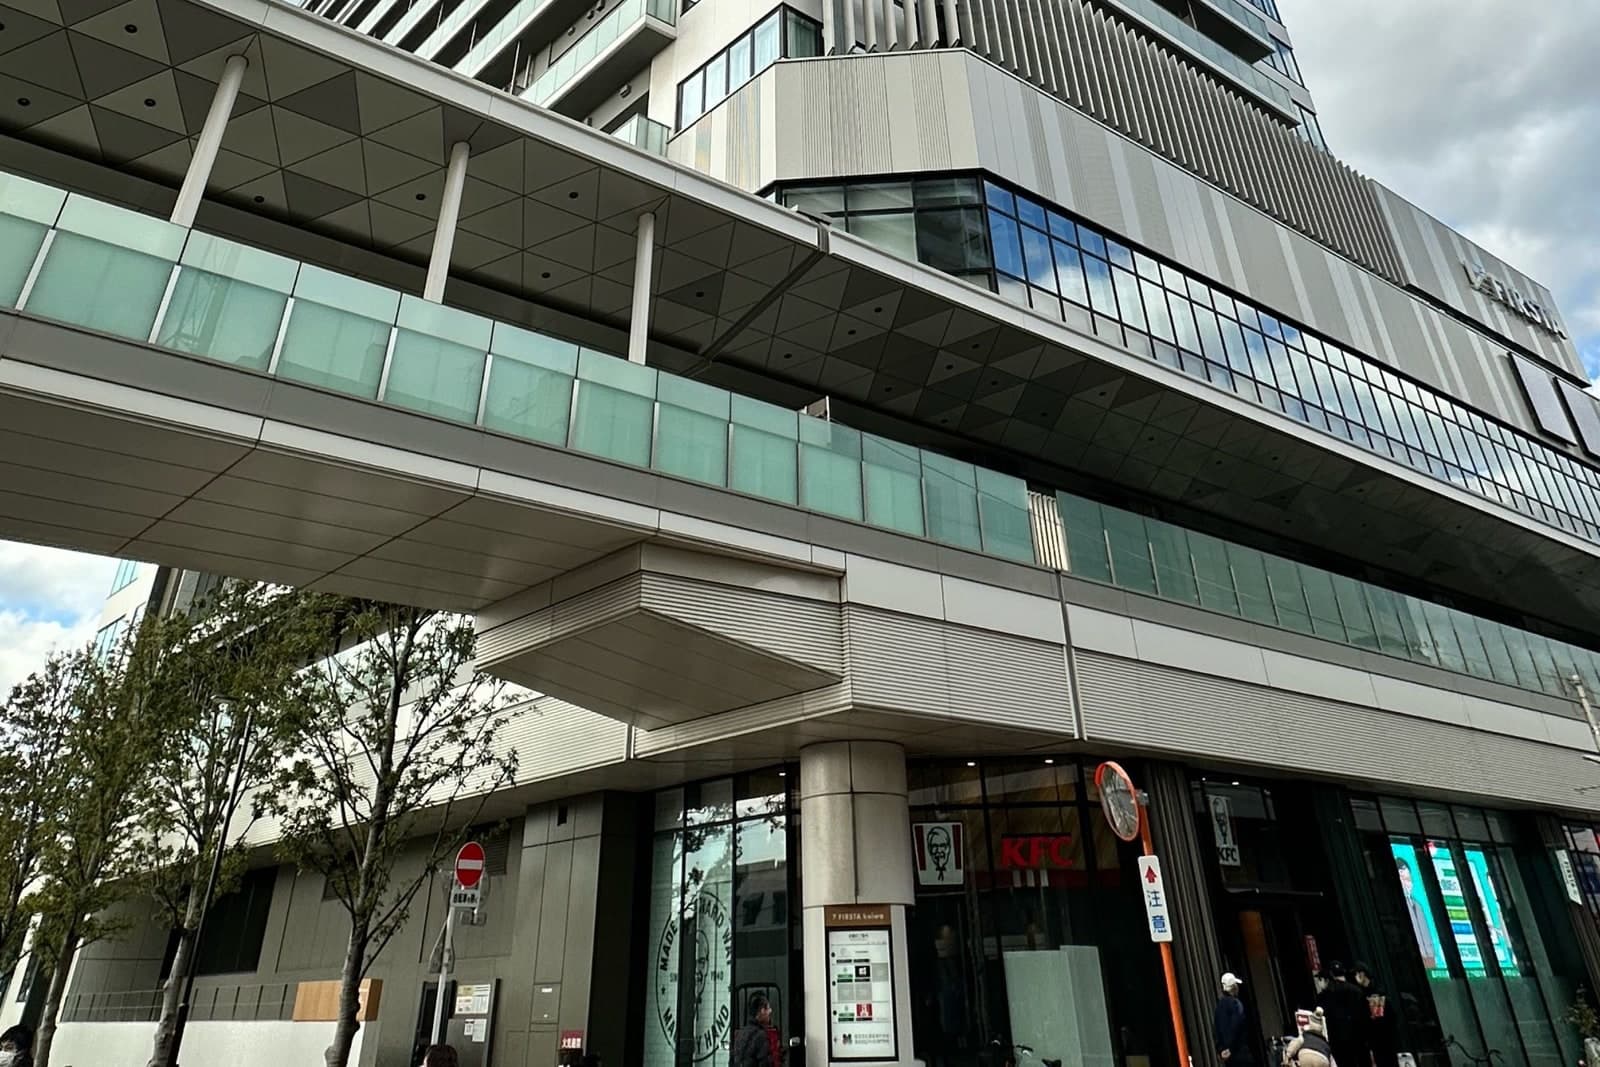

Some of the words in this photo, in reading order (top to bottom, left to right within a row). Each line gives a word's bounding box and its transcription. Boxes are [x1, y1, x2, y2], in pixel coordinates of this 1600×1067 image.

[1001, 837, 1072, 866] KFC
[1217, 847, 1237, 862] KFC
[1145, 889, 1167, 934] 注意
[660, 921, 678, 972] MADE
[704, 1004, 729, 1050] HAND
